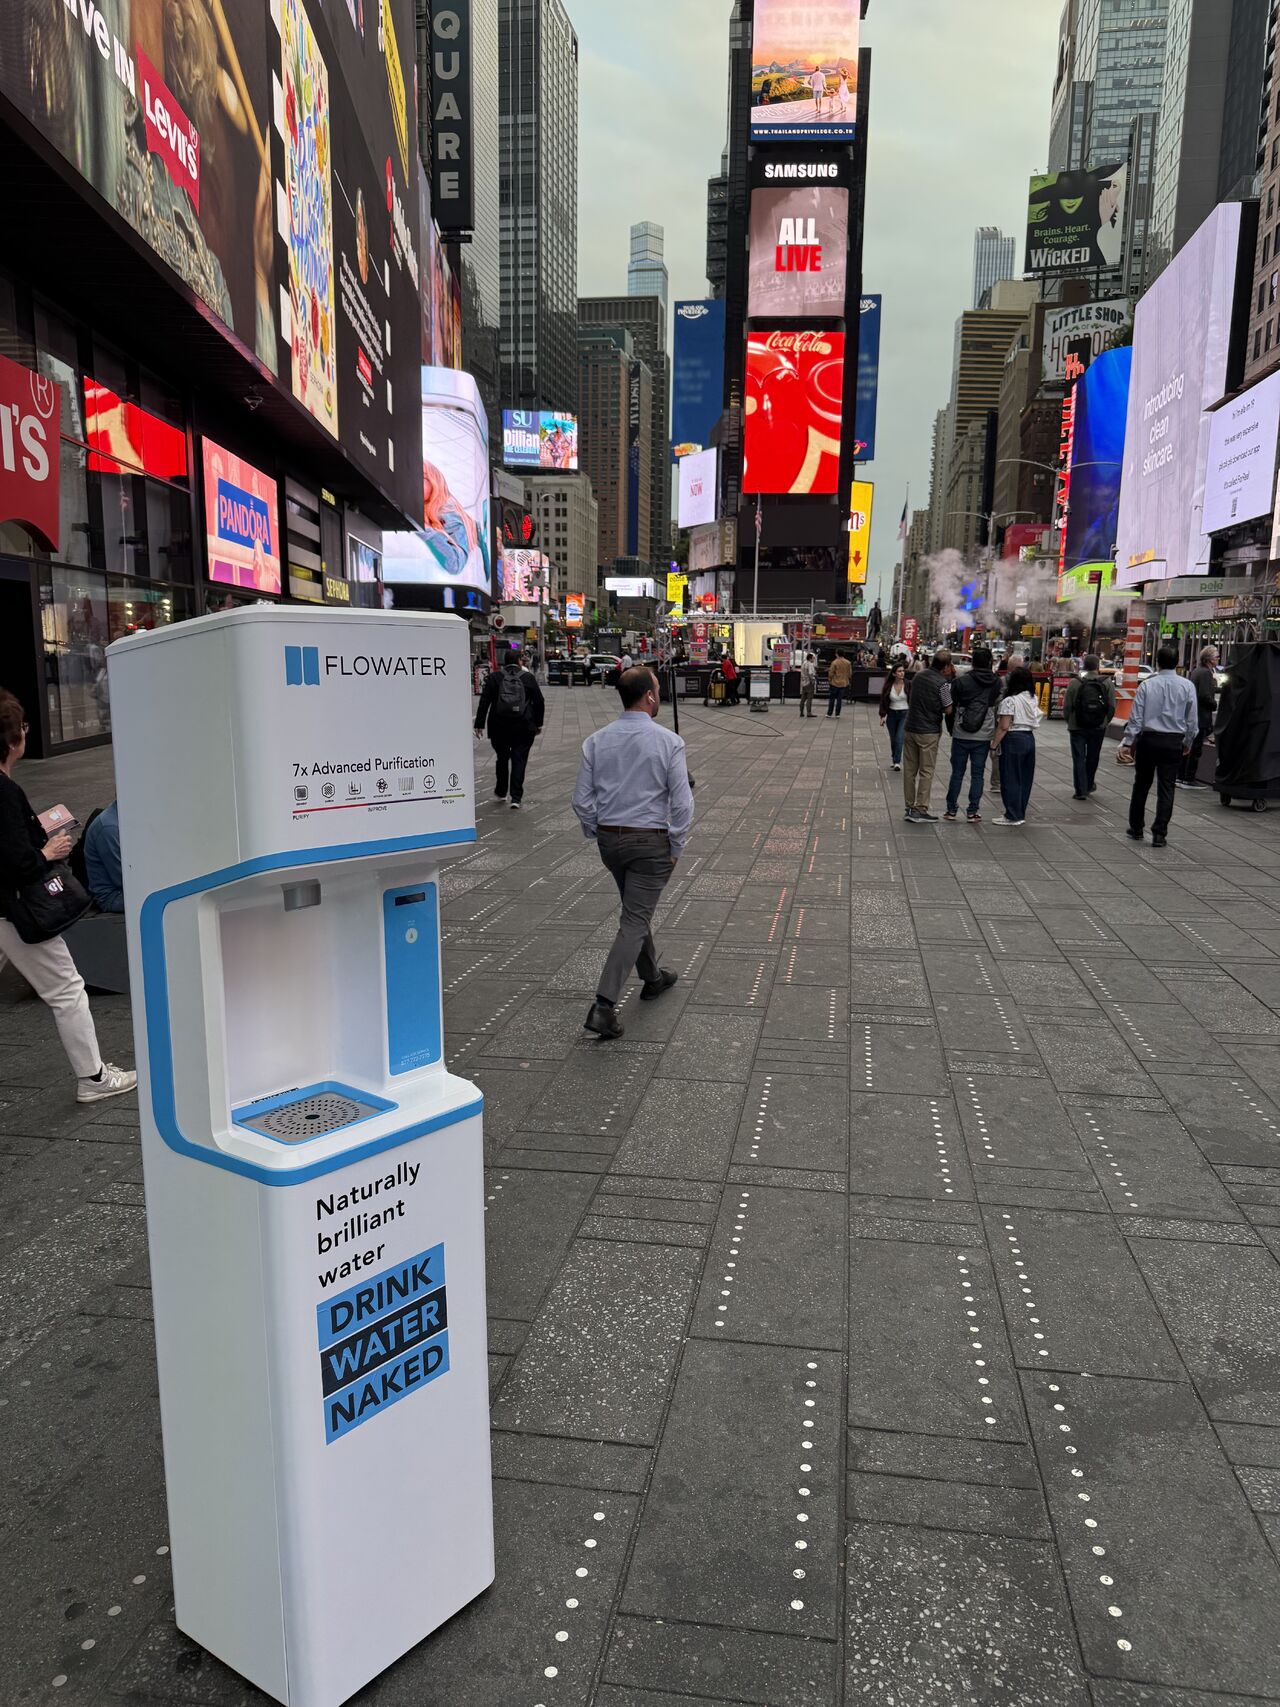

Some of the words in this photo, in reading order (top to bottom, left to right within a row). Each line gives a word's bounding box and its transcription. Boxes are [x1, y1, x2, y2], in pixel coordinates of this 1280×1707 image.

[114, 34, 136, 98] IN
[433, 10, 462, 199] QUARE
[764, 163, 838, 178] SAMSUNG
[778, 217, 820, 245] ALL
[1034, 226, 1063, 237] Brains.
[1065, 224, 1091, 234] Heart.
[1043, 235, 1080, 245] Courage.
[775, 245, 822, 272] LIVE
[1053, 307, 1093, 334] LITTLE
[1095, 307, 1124, 325] SHOP
[512, 410, 532, 427] SU
[1149, 415, 1169, 444] clean
[219, 494, 270, 546] PANDORA
[326, 576, 350, 601] SEPHORA
[325, 655, 447, 677] FLOWATER
[292, 763, 308, 777] 7x
[311, 758, 371, 776] Advanced
[374, 756, 435, 771] Purification
[315, 1161, 421, 1221] Naturally
[318, 1199, 405, 1255] brilliant
[318, 1241, 386, 1289] water
[330, 1256, 433, 1335] DRINK
[328, 1300, 440, 1383] WATER
[331, 1345, 443, 1433] NAKED
